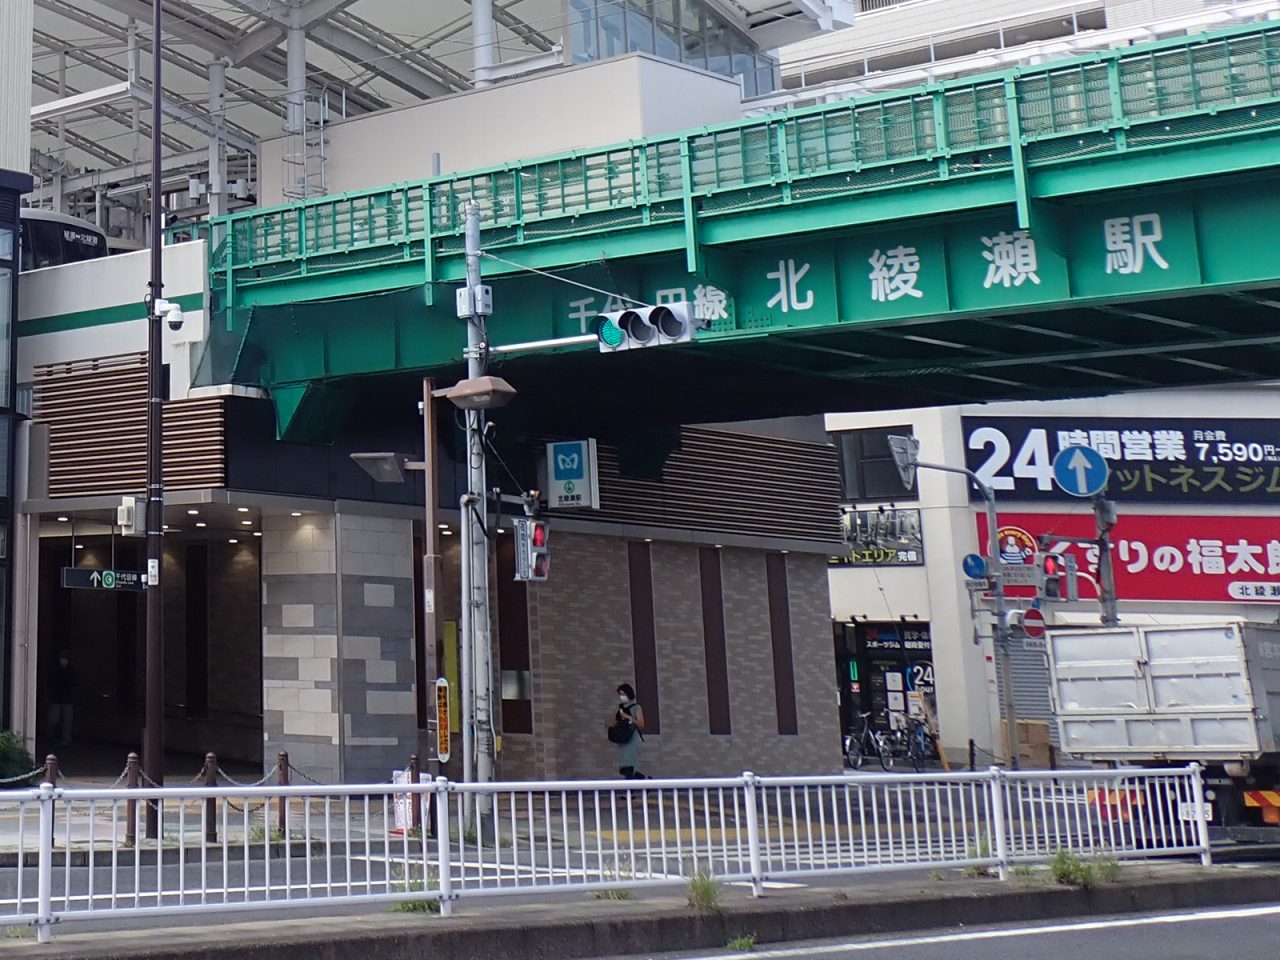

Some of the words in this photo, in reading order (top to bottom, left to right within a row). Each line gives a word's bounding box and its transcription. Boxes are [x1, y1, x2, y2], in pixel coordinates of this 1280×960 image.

[766, 213, 1170, 313] 北綾瀬駅
[913, 665, 934, 685] 24
